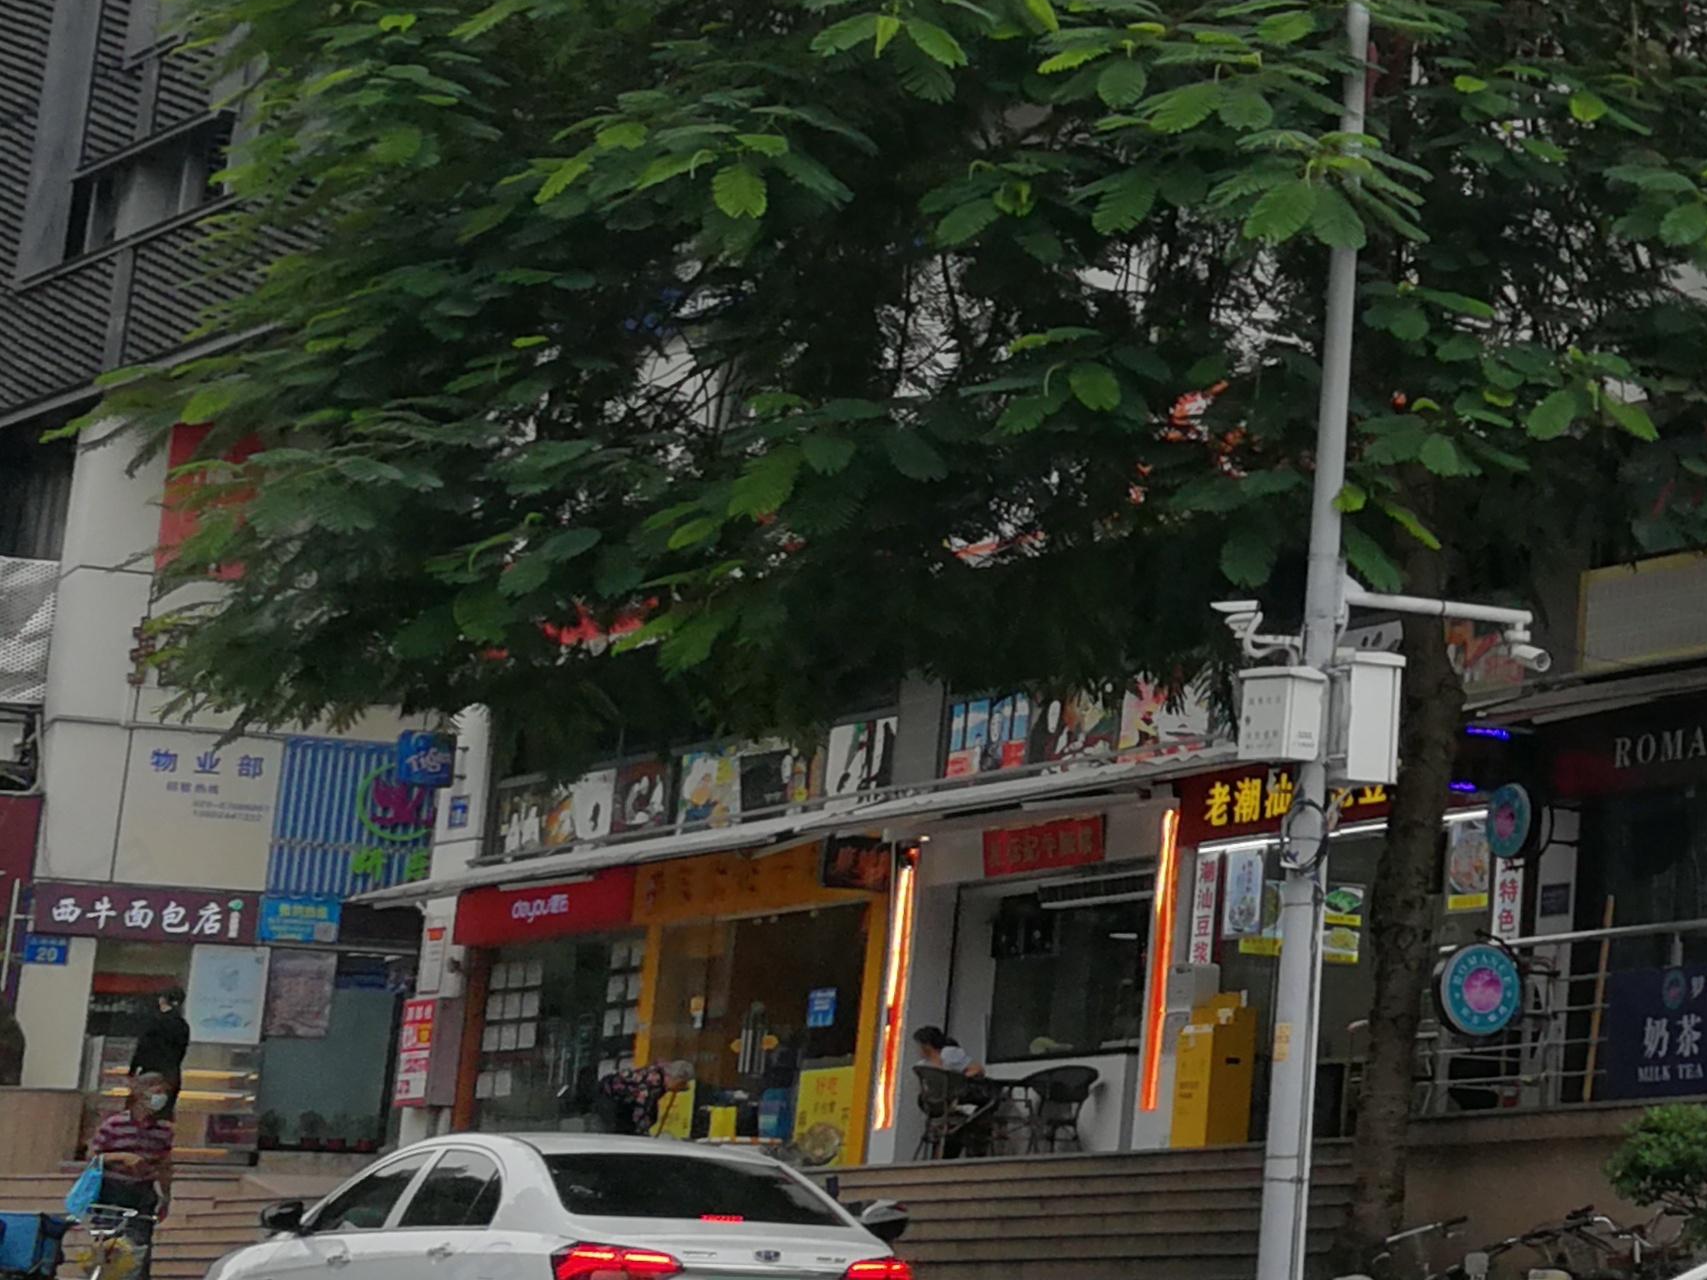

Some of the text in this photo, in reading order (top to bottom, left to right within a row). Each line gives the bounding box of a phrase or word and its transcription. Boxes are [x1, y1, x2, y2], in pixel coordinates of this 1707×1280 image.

[149, 748, 265, 779] 物业部
[50, 896, 225, 936] 西牛面包店
[1194, 859, 1216, 963] 潮汕豆浆
[35, 947, 58, 961] 20
[1642, 1012, 1704, 1059] 奶茶
[1636, 1064, 1672, 1083] MILK
[1676, 1063, 1704, 1081] TEA
